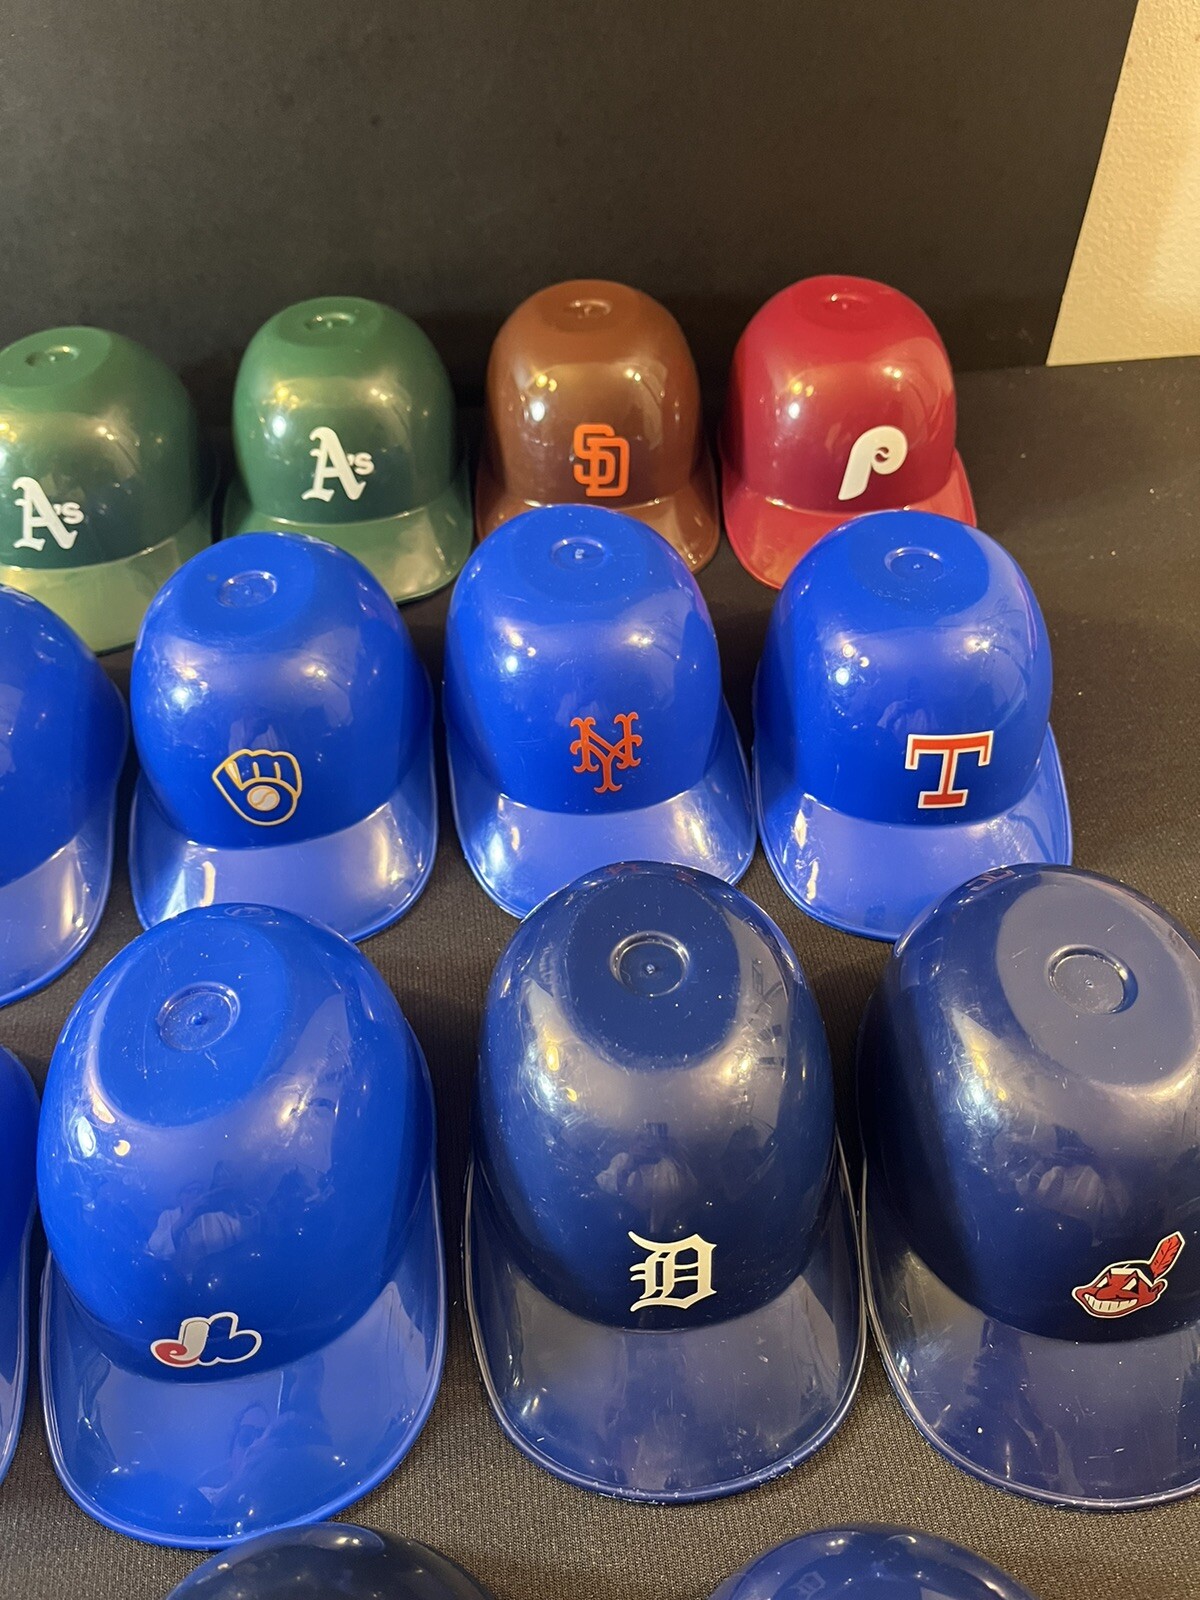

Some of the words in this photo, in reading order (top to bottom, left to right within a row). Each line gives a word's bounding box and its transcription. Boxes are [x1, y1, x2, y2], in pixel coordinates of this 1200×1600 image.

[573, 423, 630, 497] SD
[837, 425, 908, 501] P
[905, 730, 994, 809] T
[627, 1230, 718, 1312] D
